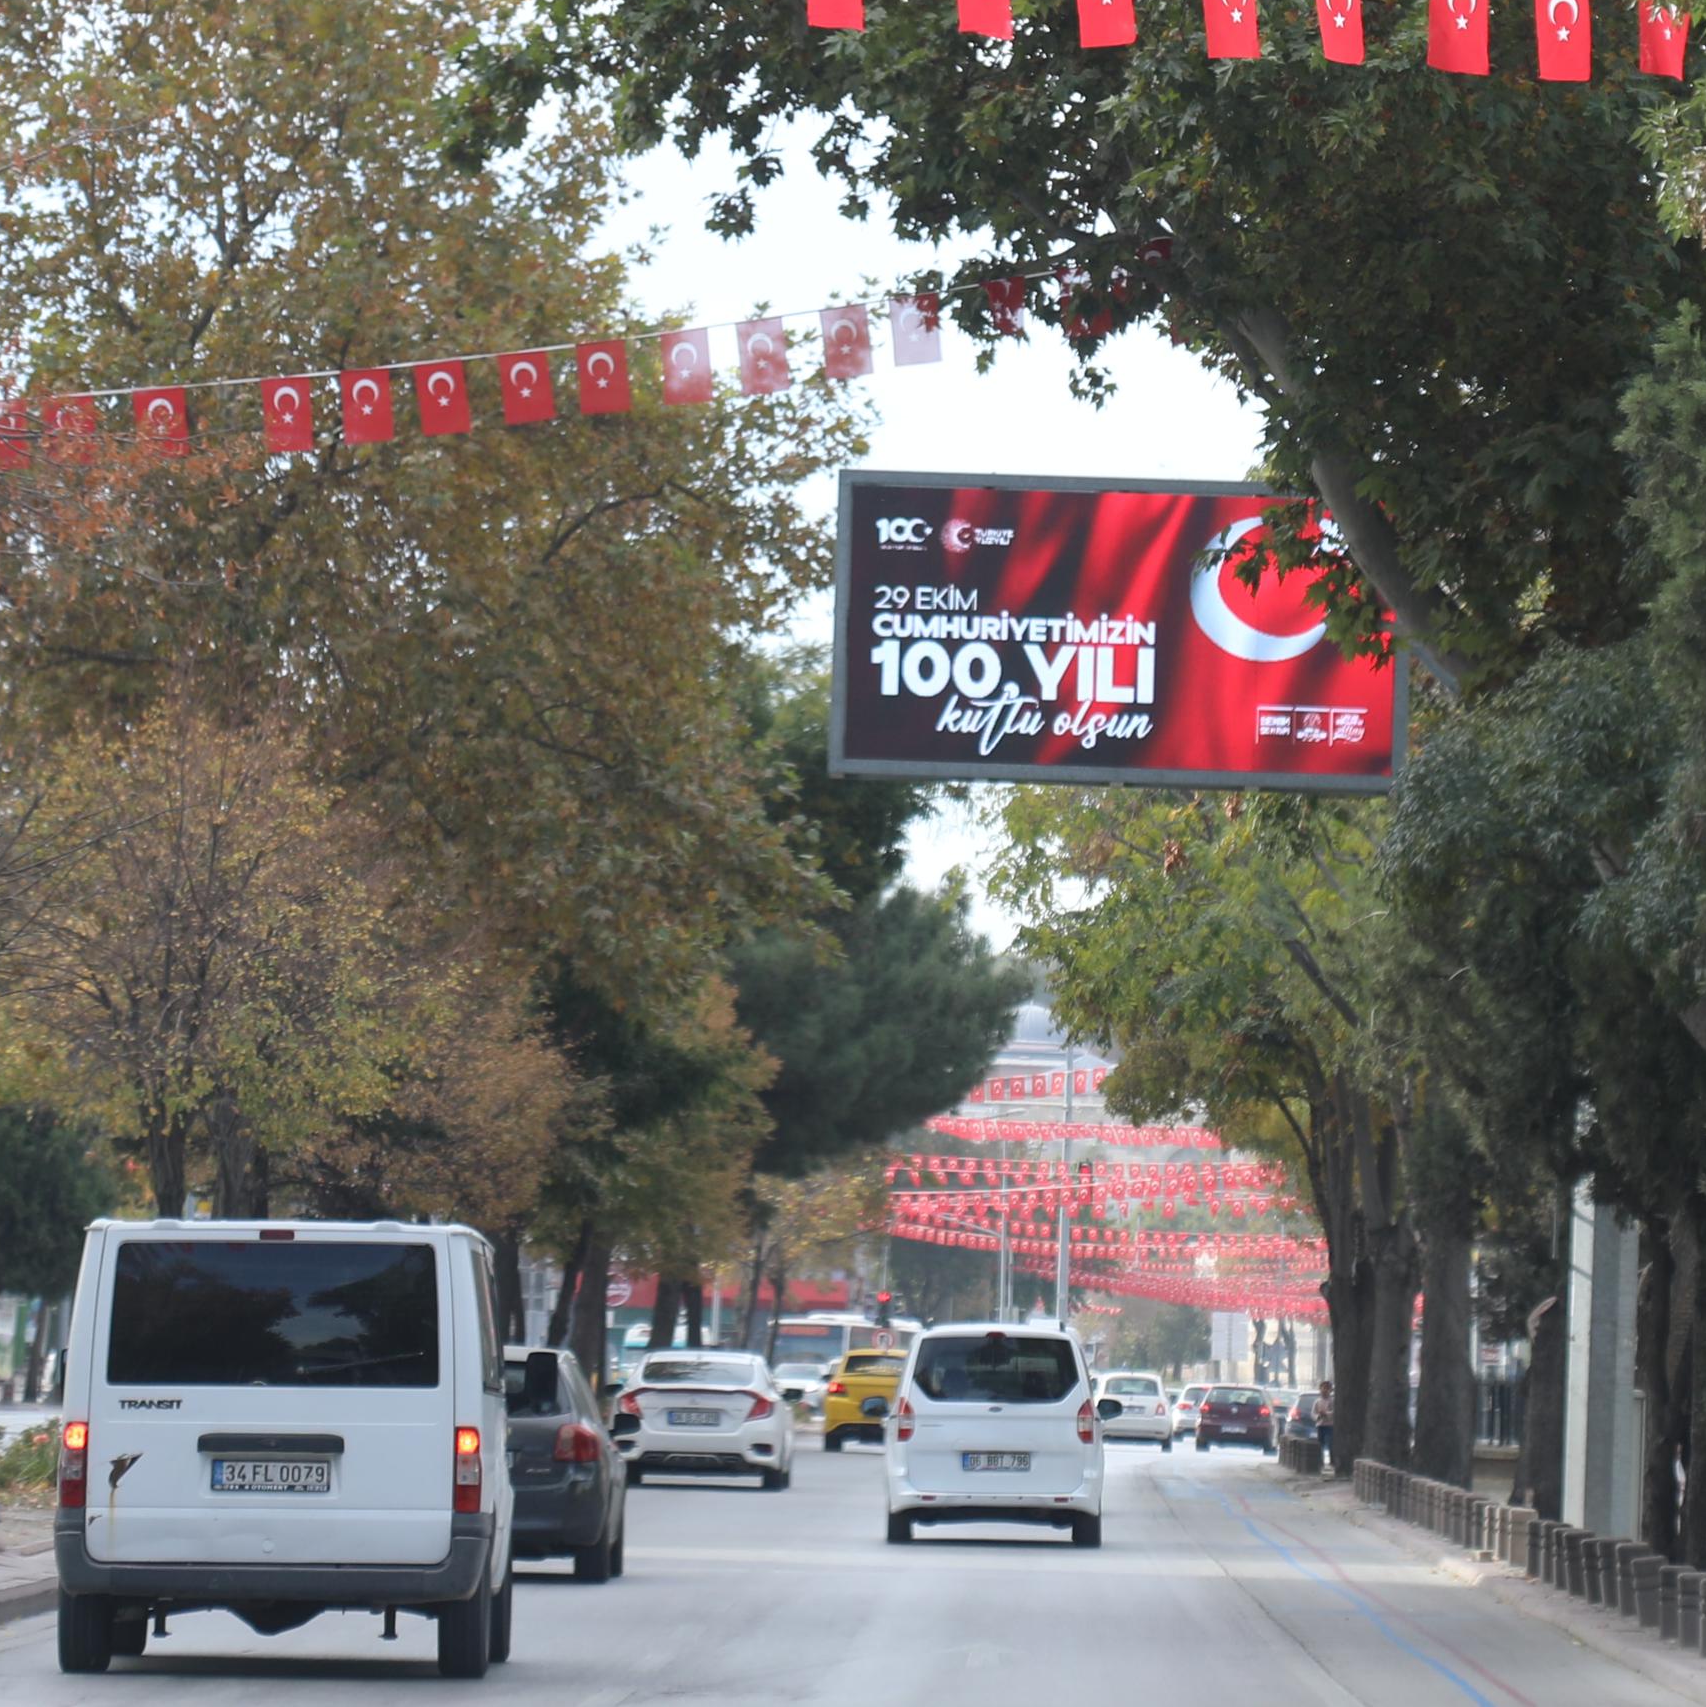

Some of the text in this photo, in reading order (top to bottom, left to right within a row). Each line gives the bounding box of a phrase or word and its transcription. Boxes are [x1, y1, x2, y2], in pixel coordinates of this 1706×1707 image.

[874, 584, 978, 611] 29 EKİM
[871, 610, 1157, 645] CUMHURİYETİMİZİN
[871, 639, 1156, 704] 100. YILI
[935, 695, 1154, 756] kutlu olsun
[118, 1399, 183, 1410] TRANSIT
[225, 1464, 325, 1483] 34 FL 0079
